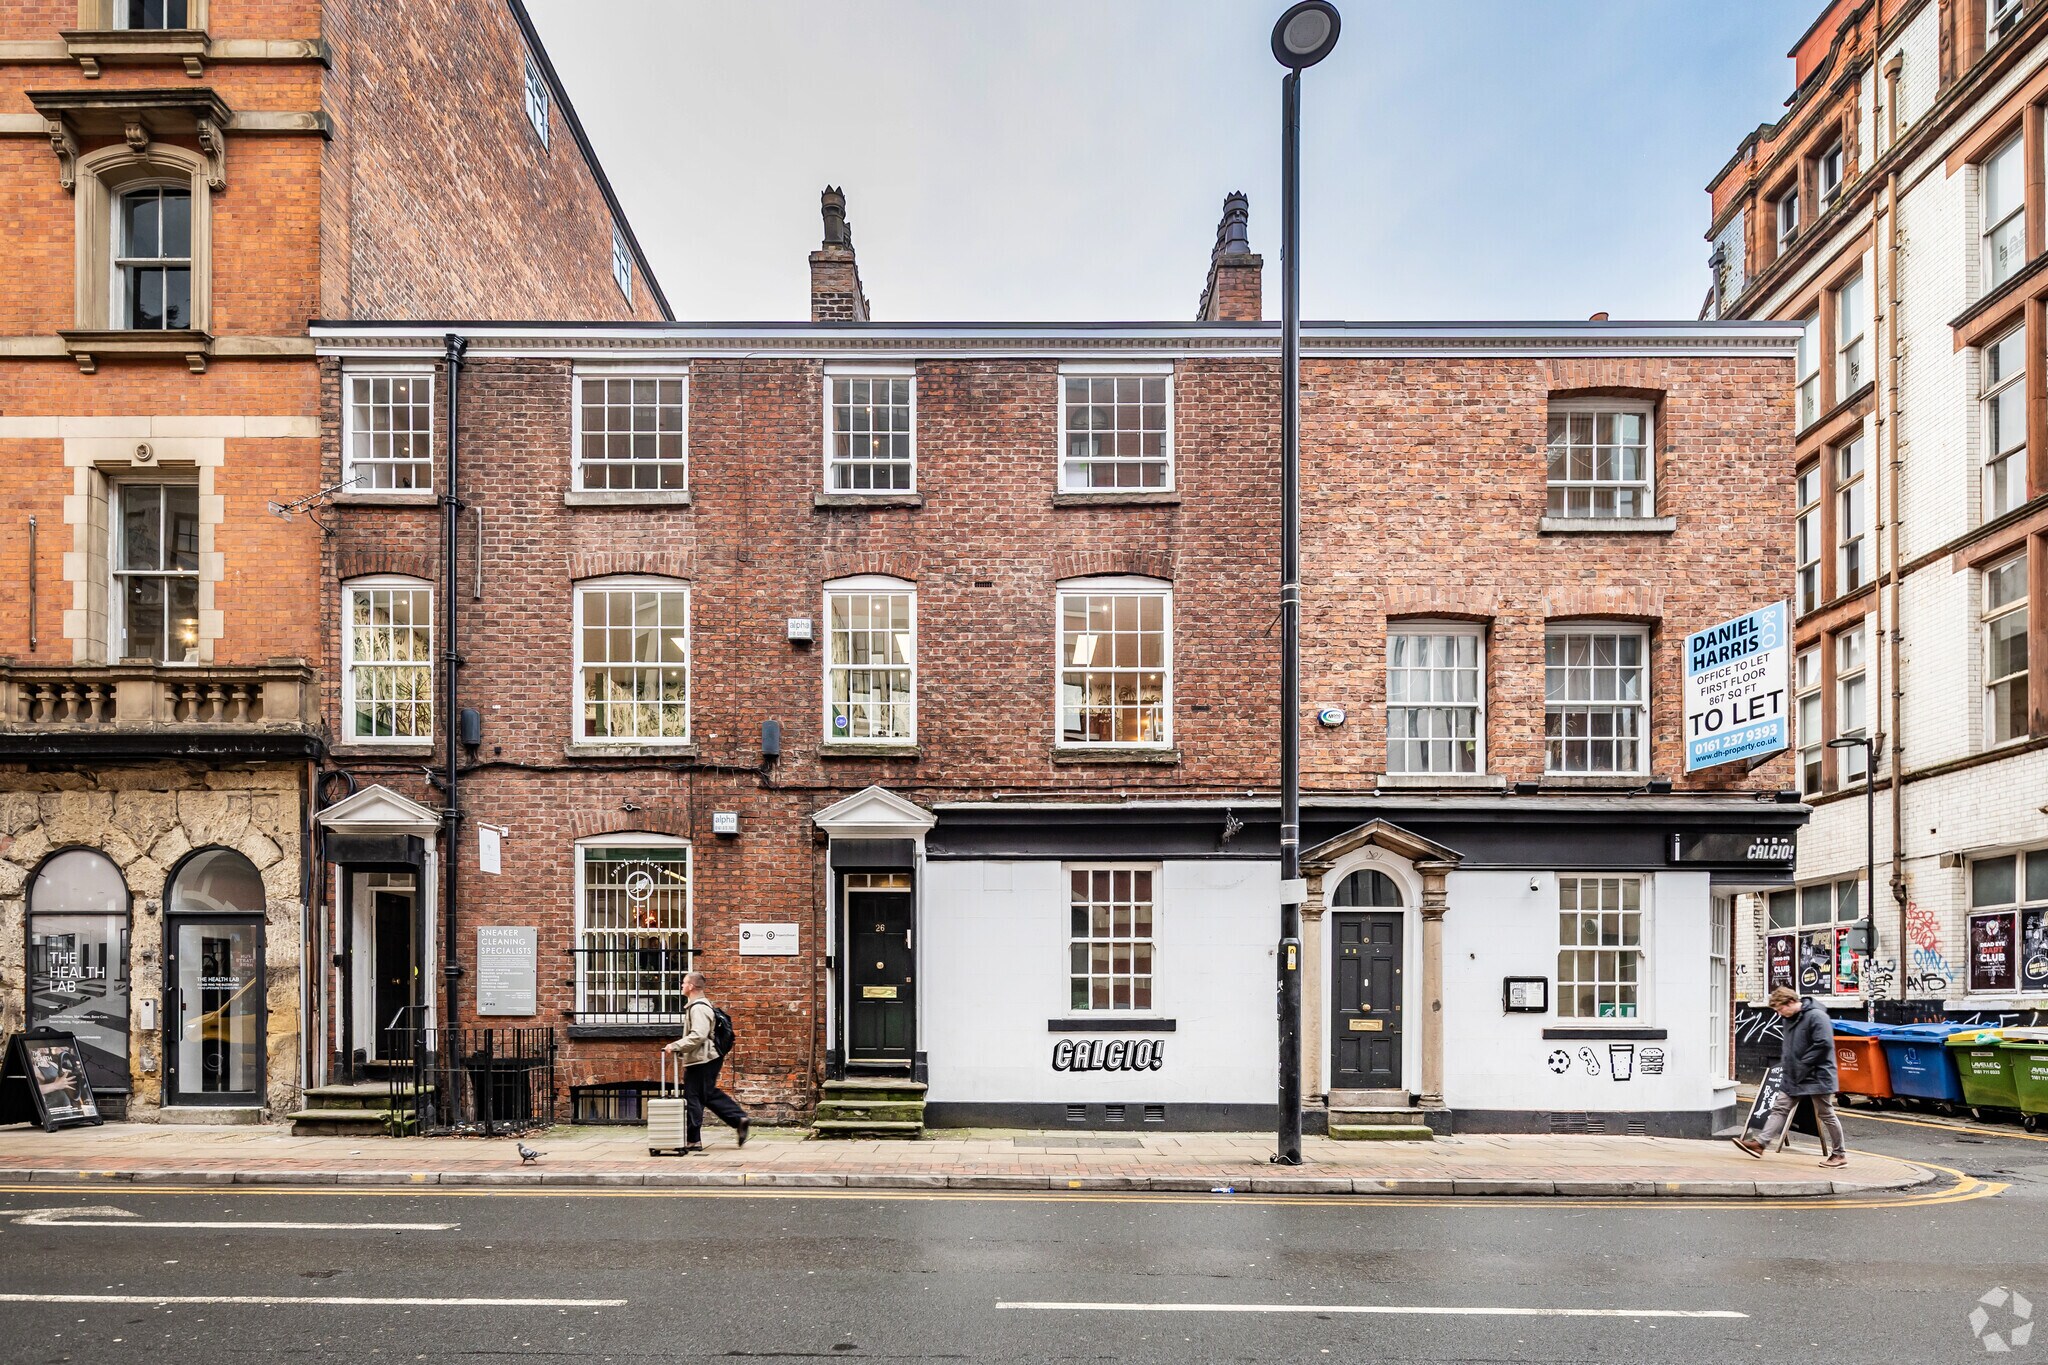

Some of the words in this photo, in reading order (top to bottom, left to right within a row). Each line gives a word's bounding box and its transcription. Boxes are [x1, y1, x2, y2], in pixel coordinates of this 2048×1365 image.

[789, 620, 810, 630] alpha
[1761, 610, 1777, 649] &CO
[1693, 616, 1759, 653] DANIEL
[1693, 634, 1759, 672] HARRIS
[1696, 665, 1732, 685] OFFICE
[1734, 660, 1748, 673] TO
[1750, 652, 1771, 668] LET
[1700, 680, 1728, 697] FIRST
[1730, 667, 1766, 687] FLOOR
[1709, 693, 1725, 706] 867
[1727, 688, 1742, 701] SQ
[1744, 682, 1757, 695] FT
[1689, 707, 1723, 736] TO
[1732, 688, 1784, 726] LET
[1694, 738, 1720, 755] 0161
[1722, 731, 1745, 749] 237
[1746, 723, 1778, 742] 9393
[1695, 736, 1778, 763] www.dh-property.co.uk
[715, 814, 735, 825] alpha
[1747, 844, 1795, 860] CALCIO!
[875, 923, 885, 932] 26
[481, 938, 526, 946] CLEANING
[481, 947, 532, 955] SPECIALISTS
[1982, 946, 2004, 954] DART
[49, 952, 77, 964] THE
[1980, 953, 2006, 962] CLUB
[50, 966, 105, 979] HEALTH
[1773, 965, 1790, 973] CLUB
[49, 980, 76, 993] LAB
[1052, 1039, 1165, 1072] CALCIO!
